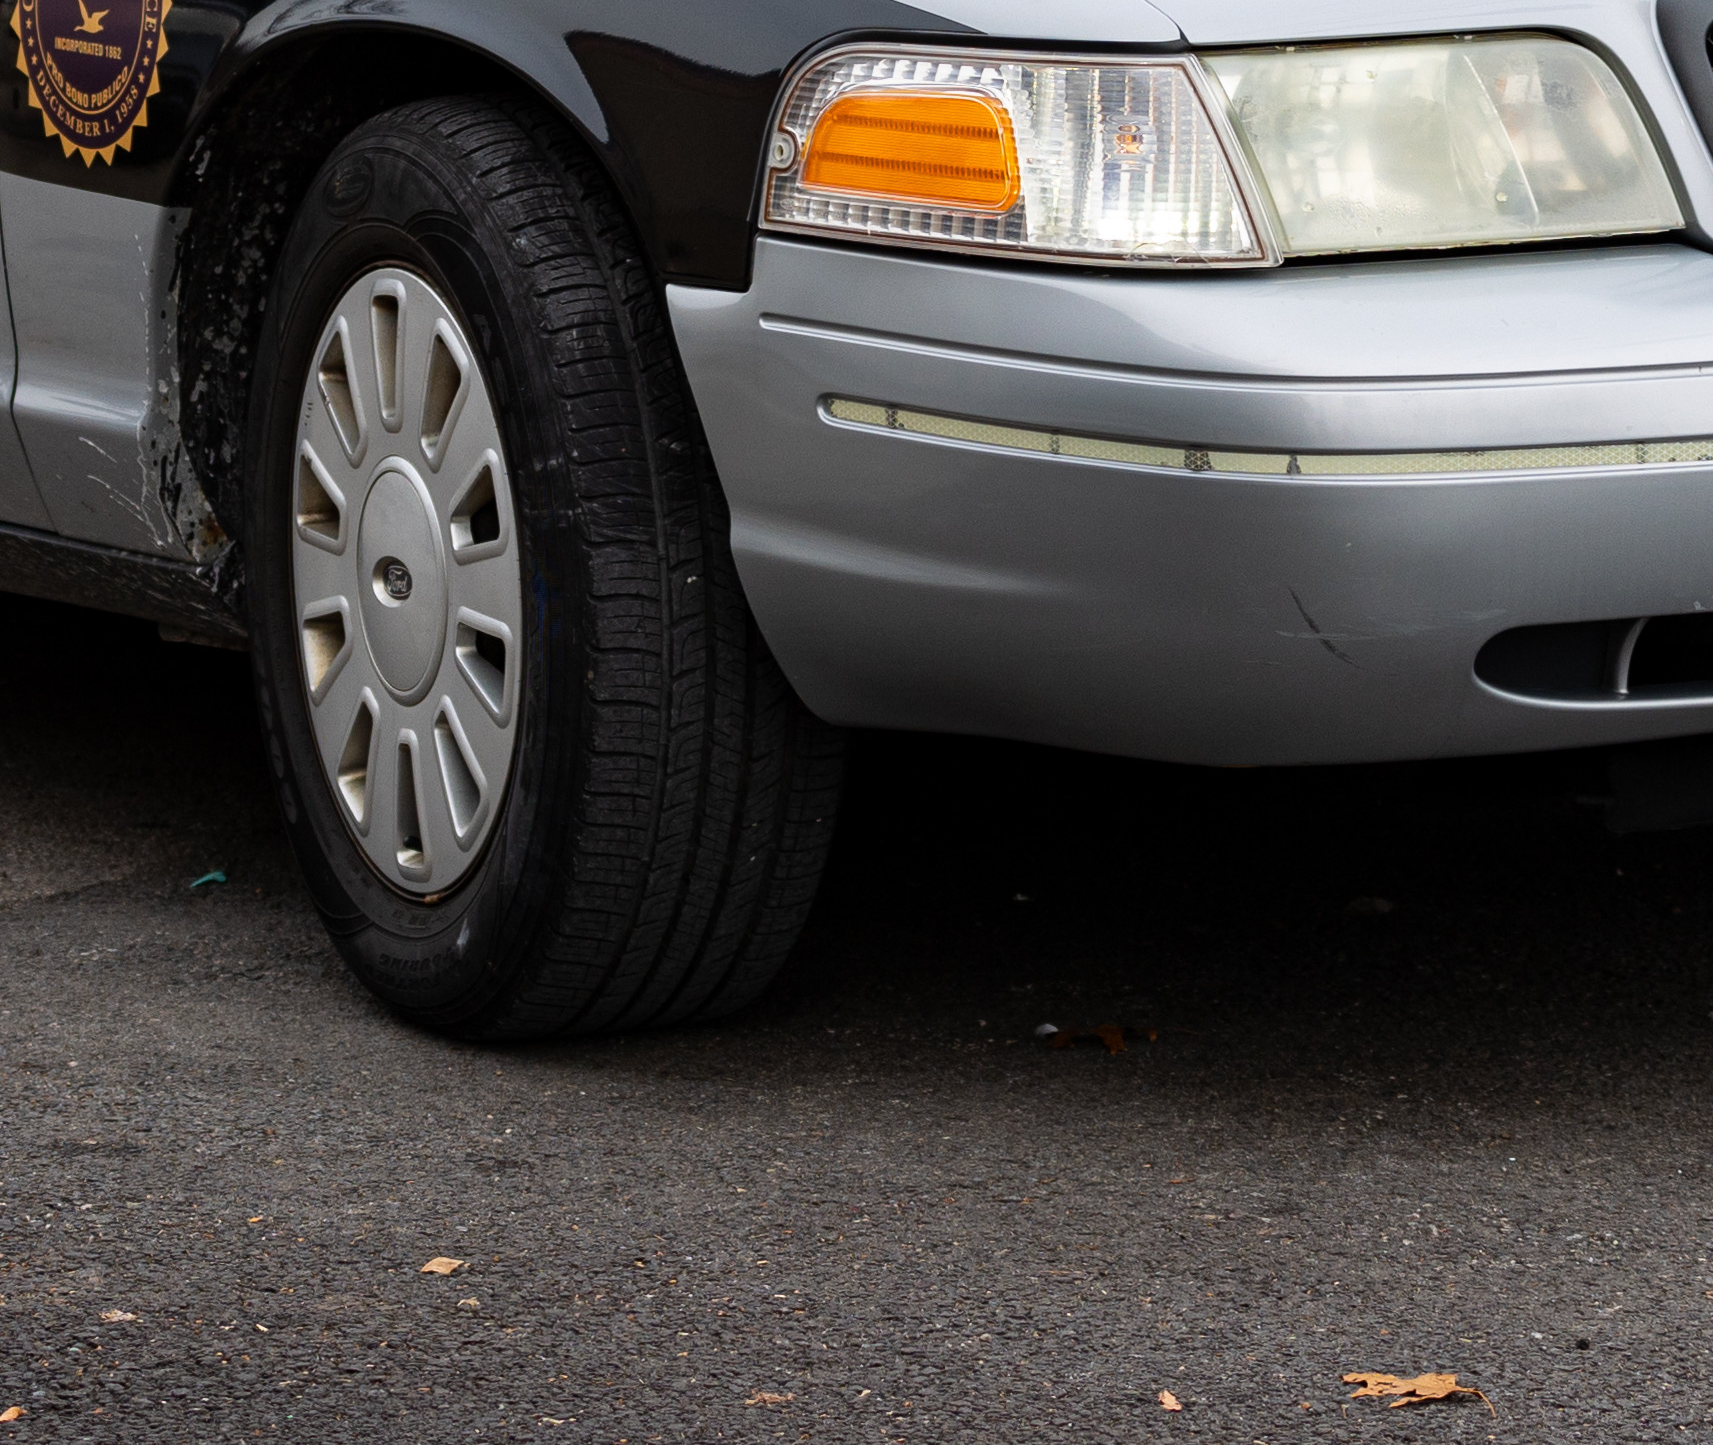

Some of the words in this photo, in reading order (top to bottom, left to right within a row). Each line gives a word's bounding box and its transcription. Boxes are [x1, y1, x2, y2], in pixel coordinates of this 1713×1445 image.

[54, 36, 104, 57] INCORPORATED
[36, 69, 101, 137] DECEMBER
[115, 84, 139, 124] 1958
[46, 51, 64, 88] PRO
[65, 81, 89, 108] BONO
[91, 65, 128, 108] PUBLICO
